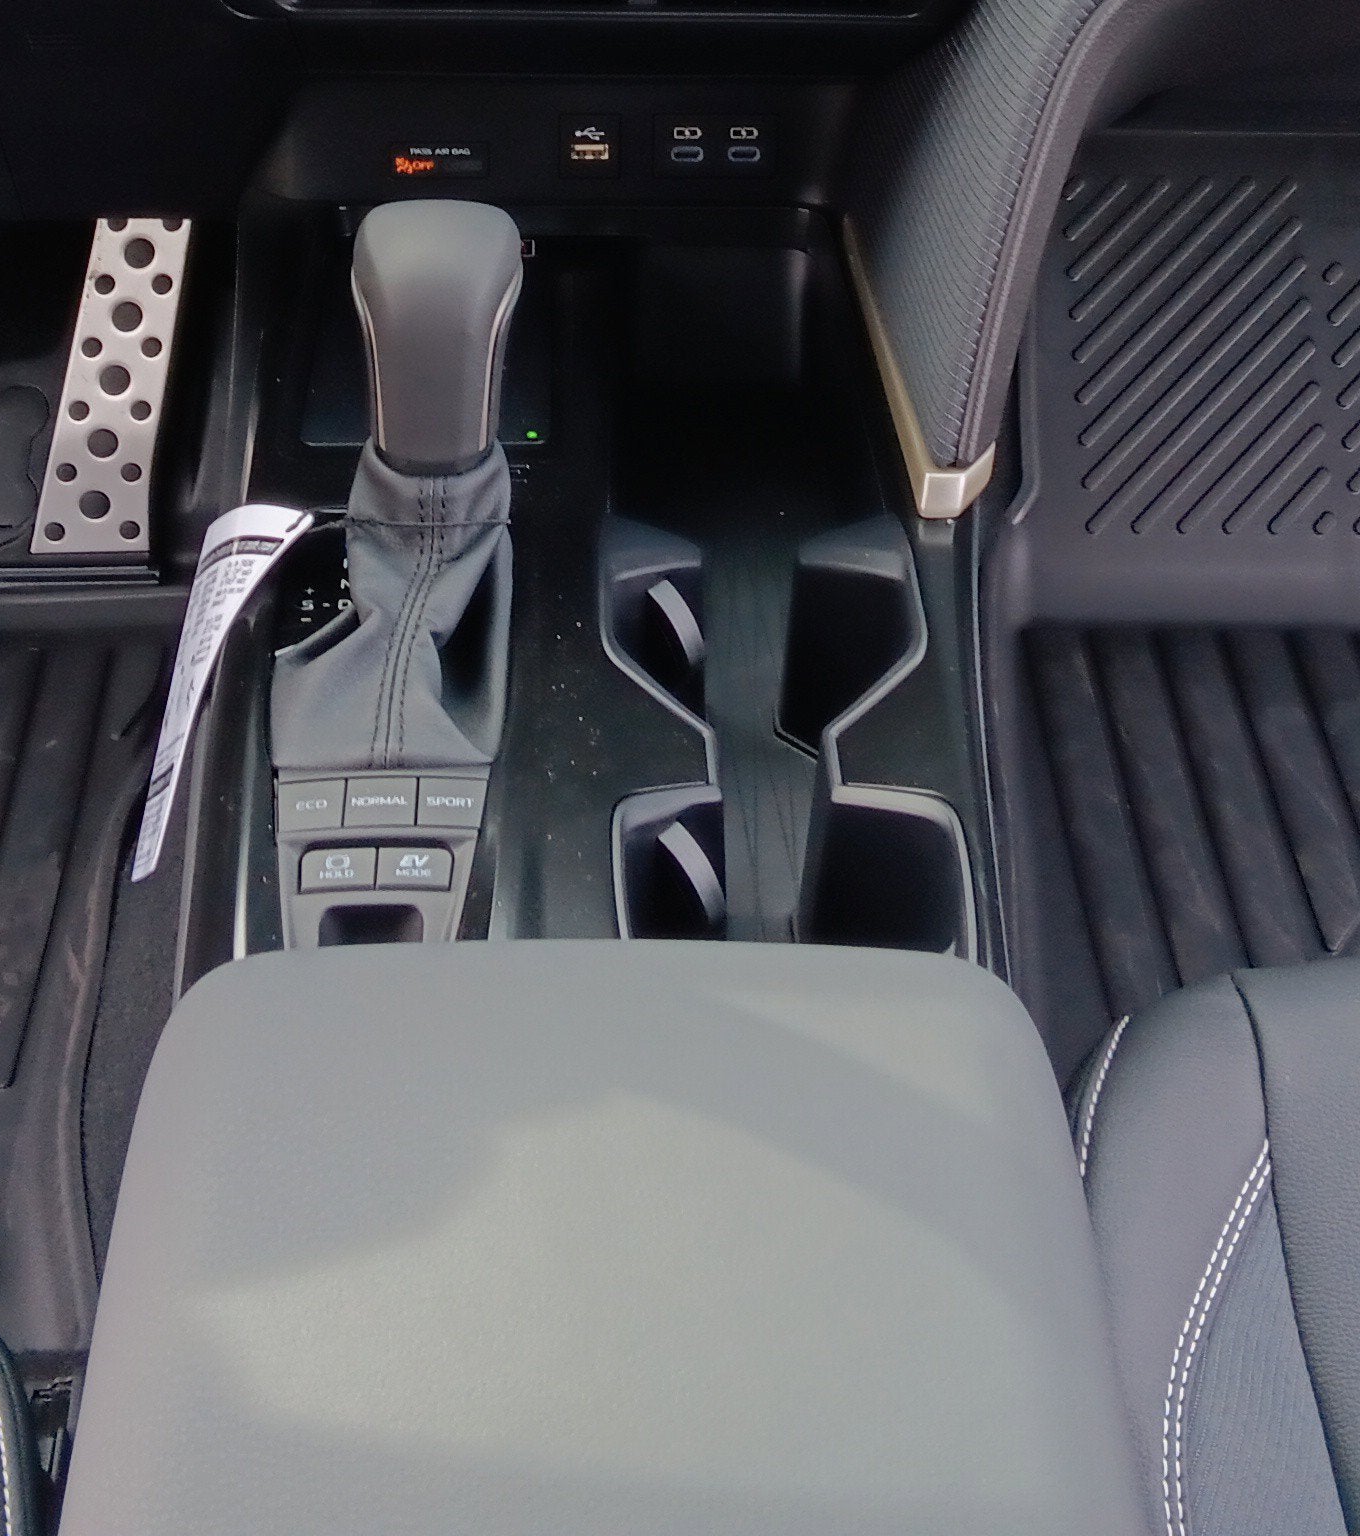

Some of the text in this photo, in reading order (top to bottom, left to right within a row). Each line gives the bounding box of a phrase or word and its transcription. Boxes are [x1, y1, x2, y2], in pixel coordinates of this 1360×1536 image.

[295, 798, 328, 811] ECO
[351, 795, 408, 807] NORMAL
[426, 796, 475, 808] SPORT
[319, 868, 355, 880] HOLD
[395, 868, 432, 878] MODE
